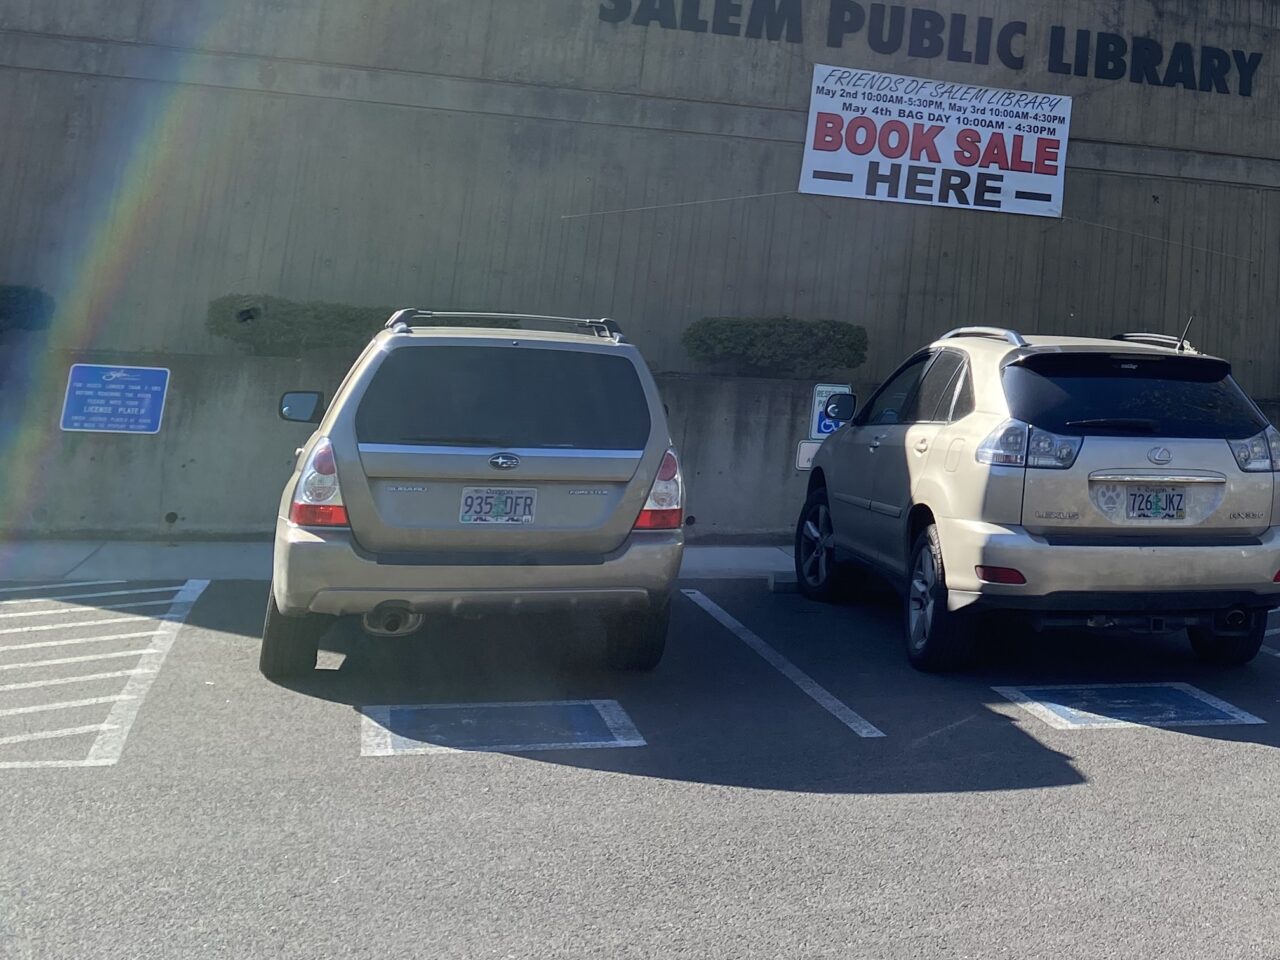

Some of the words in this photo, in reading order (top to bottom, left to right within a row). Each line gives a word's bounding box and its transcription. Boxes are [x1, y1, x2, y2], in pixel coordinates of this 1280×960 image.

[1048, 25, 1263, 96] LIBRARY
[816, 85, 837, 99] May
[840, 88, 858, 100] 2nd
[861, 91, 945, 112] 10:00AM-5:30PM,
[948, 102, 968, 115] May
[970, 105, 986, 115] 3rd
[989, 108, 1066, 125] 10:00AM-4:30PM
[823, 69, 905, 92] FRIENDS
[904, 79, 933, 95] OF
[930, 83, 989, 103] SALEM
[987, 90, 1063, 113] LIBRARY
[842, 102, 867, 116] May
[872, 106, 892, 117] 4th
[898, 108, 924, 120] BAG
[928, 112, 952, 123] DAY
[955, 116, 1005, 130] 10:00AM
[1015, 123, 1056, 136] 4:30PM
[813, 111, 945, 163] BOOK
[954, 128, 1061, 176] SALE
[865, 161, 1004, 208] HERE
[83, 406, 112, 414] LICENSE
[118, 407, 139, 415] PLATE
[464, 496, 493, 515] 935
[504, 496, 533, 515] DFR
[1035, 511, 1079, 520] LEXUS
[1129, 493, 1152, 510] 726
[1161, 493, 1183, 511] JKZ
